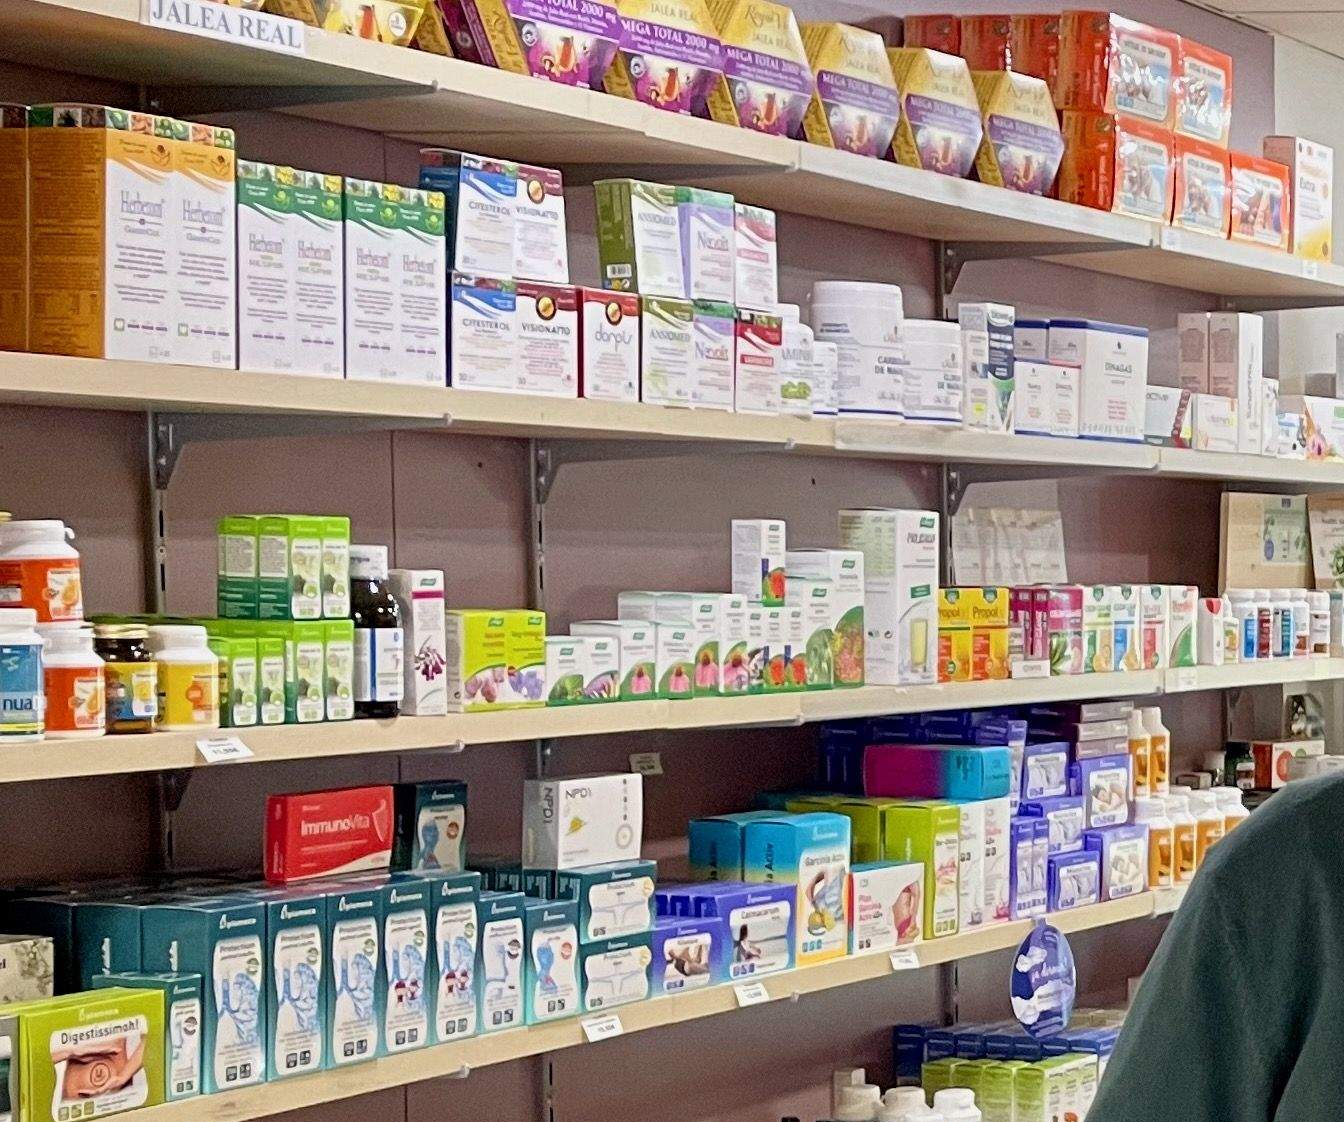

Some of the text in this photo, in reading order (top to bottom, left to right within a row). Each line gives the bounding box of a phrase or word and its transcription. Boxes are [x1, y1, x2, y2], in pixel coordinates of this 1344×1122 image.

[152, 0, 302, 48] JALEA REAL
[653, 26, 683, 44] TOTAL
